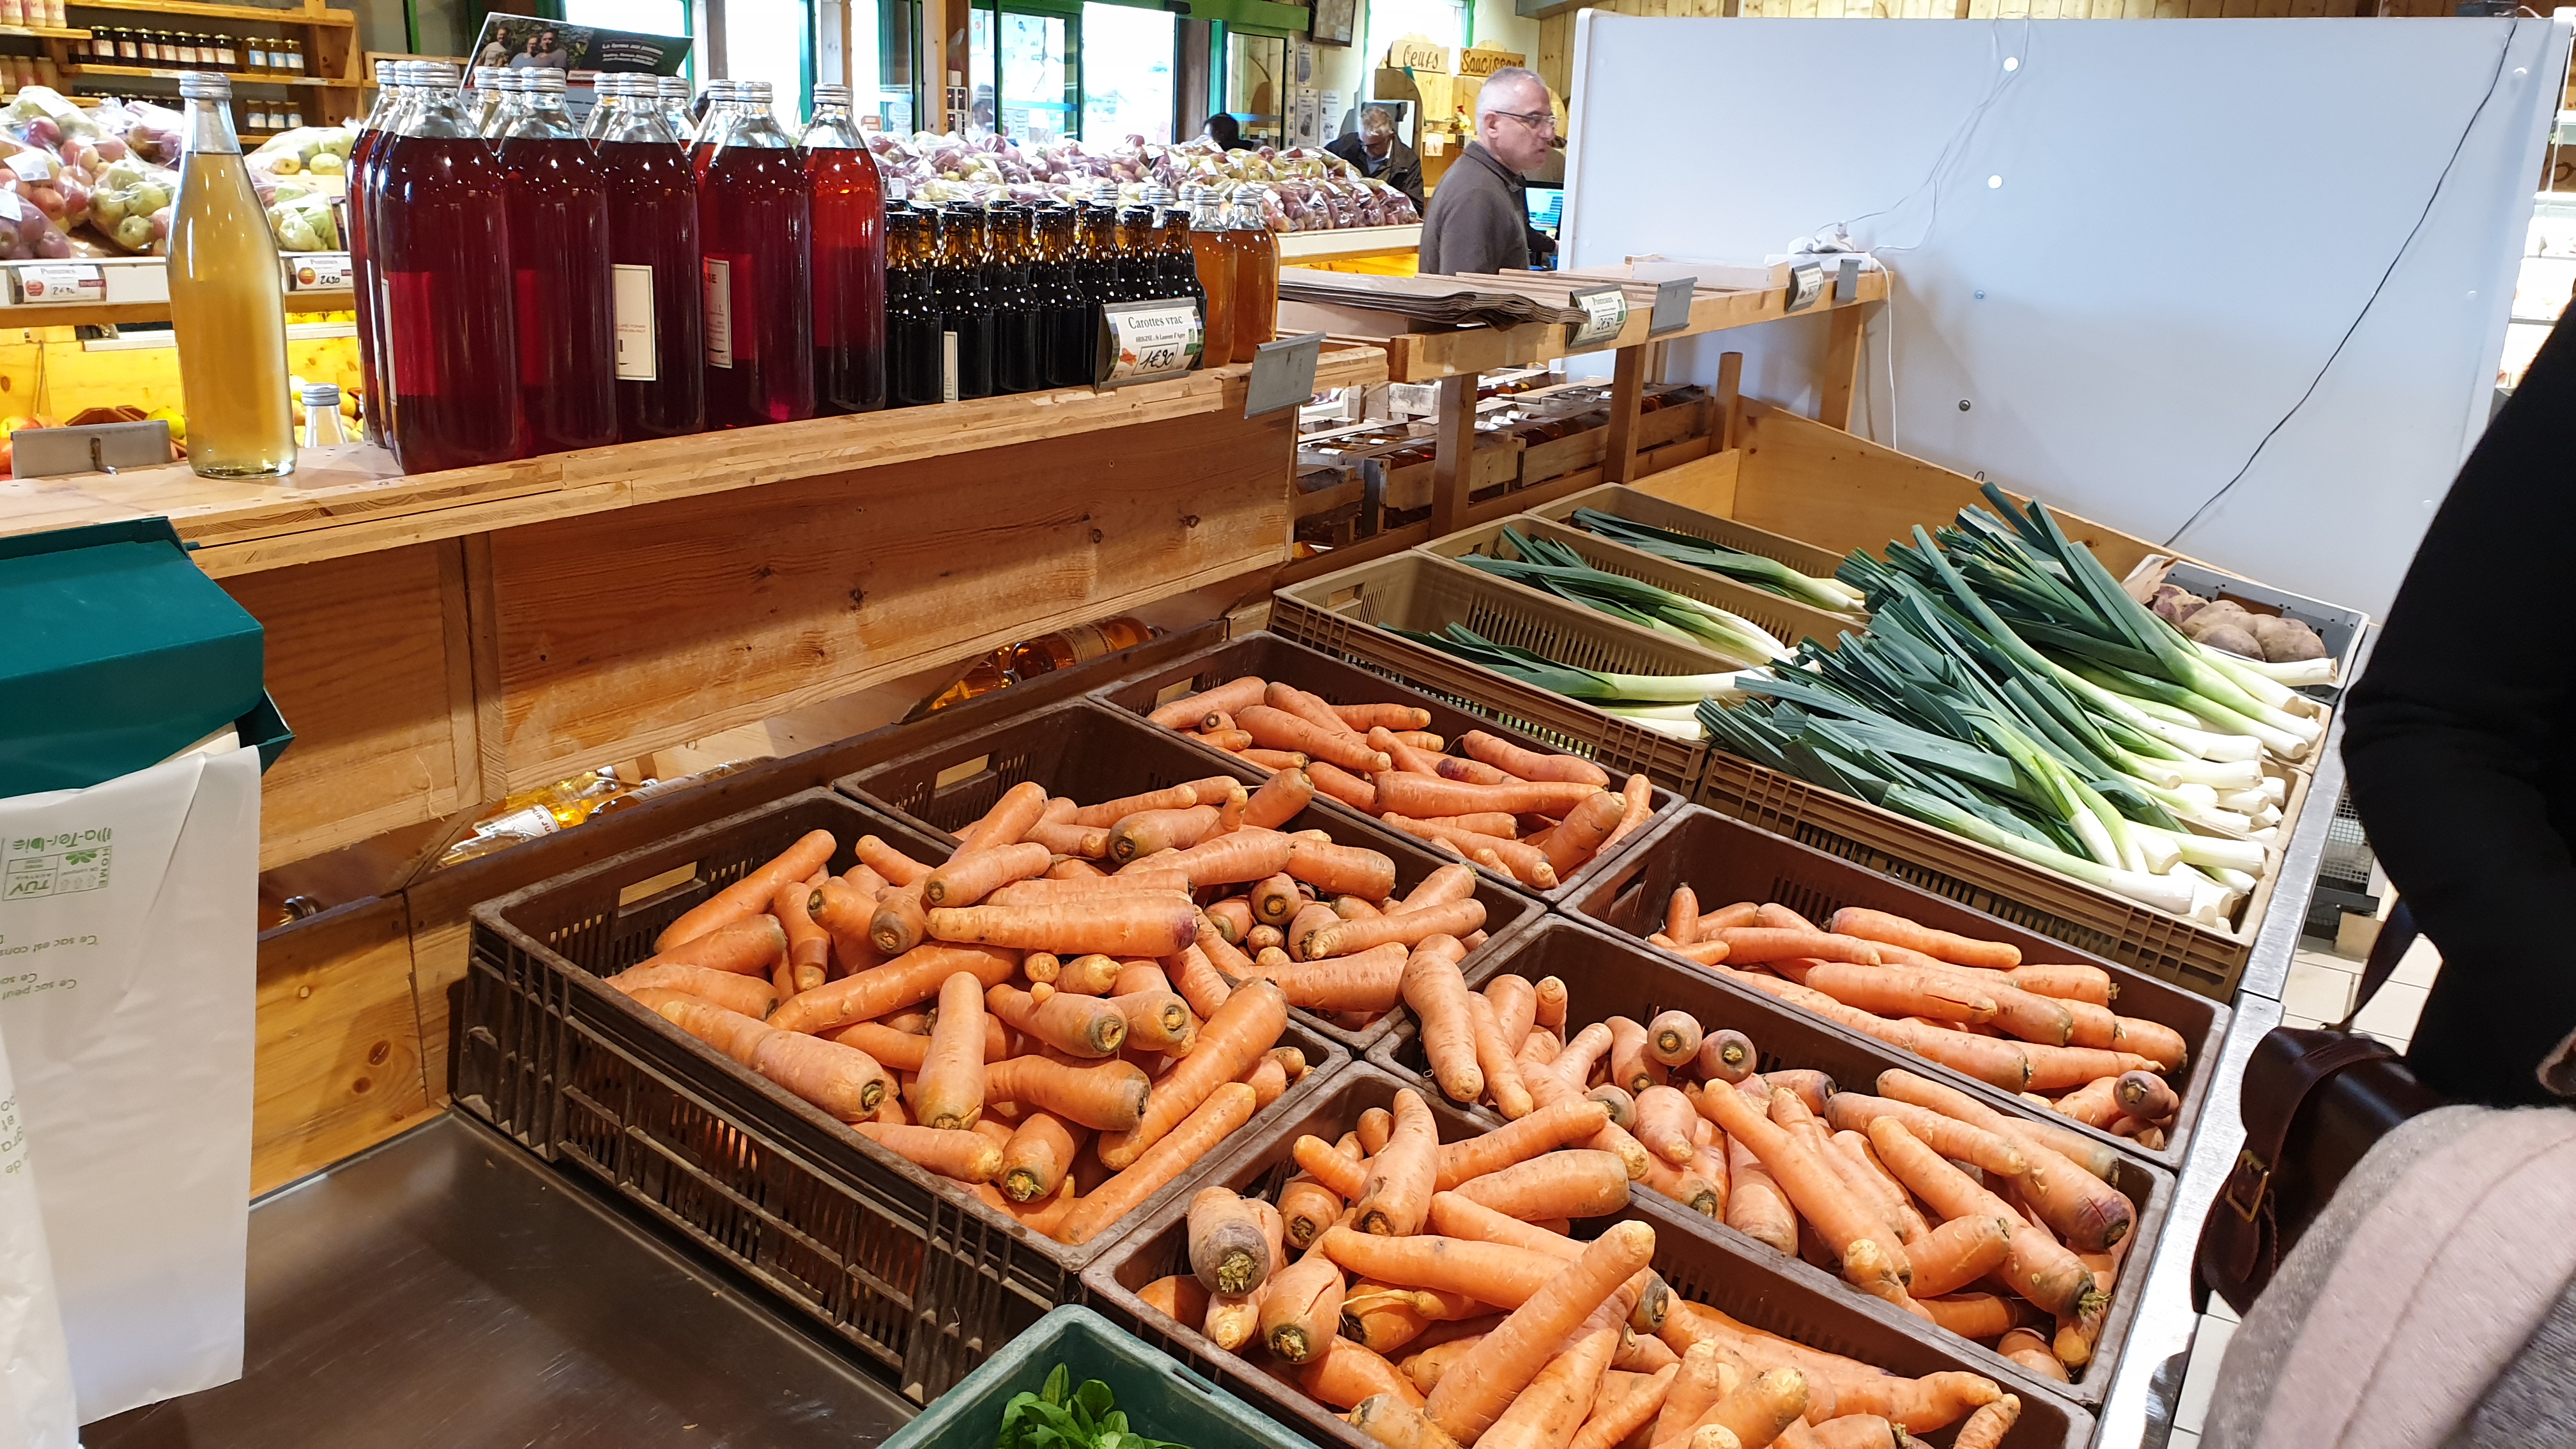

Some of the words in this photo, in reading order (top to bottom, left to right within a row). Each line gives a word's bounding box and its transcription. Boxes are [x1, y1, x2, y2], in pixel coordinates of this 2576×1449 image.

[1403, 44, 1439, 69] Oeufs
[1128, 316, 1164, 330] Carottes
[1165, 316, 1183, 325] vrac
[1140, 349, 1175, 370] 1€90
[541, 822, 553, 834] JU
[98, 848, 111, 887] HOME
[8, 879, 50, 896] TÜV
[53, 937, 75, 946] sac
[80, 935, 97, 946] Ce
[33, 941, 50, 953] est
[0, 976, 16, 985] sa
[20, 973, 37, 983] Ce
[59, 979, 77, 989] Ce
[2, 985, 31, 1000] peut
[34, 981, 55, 992] sac
